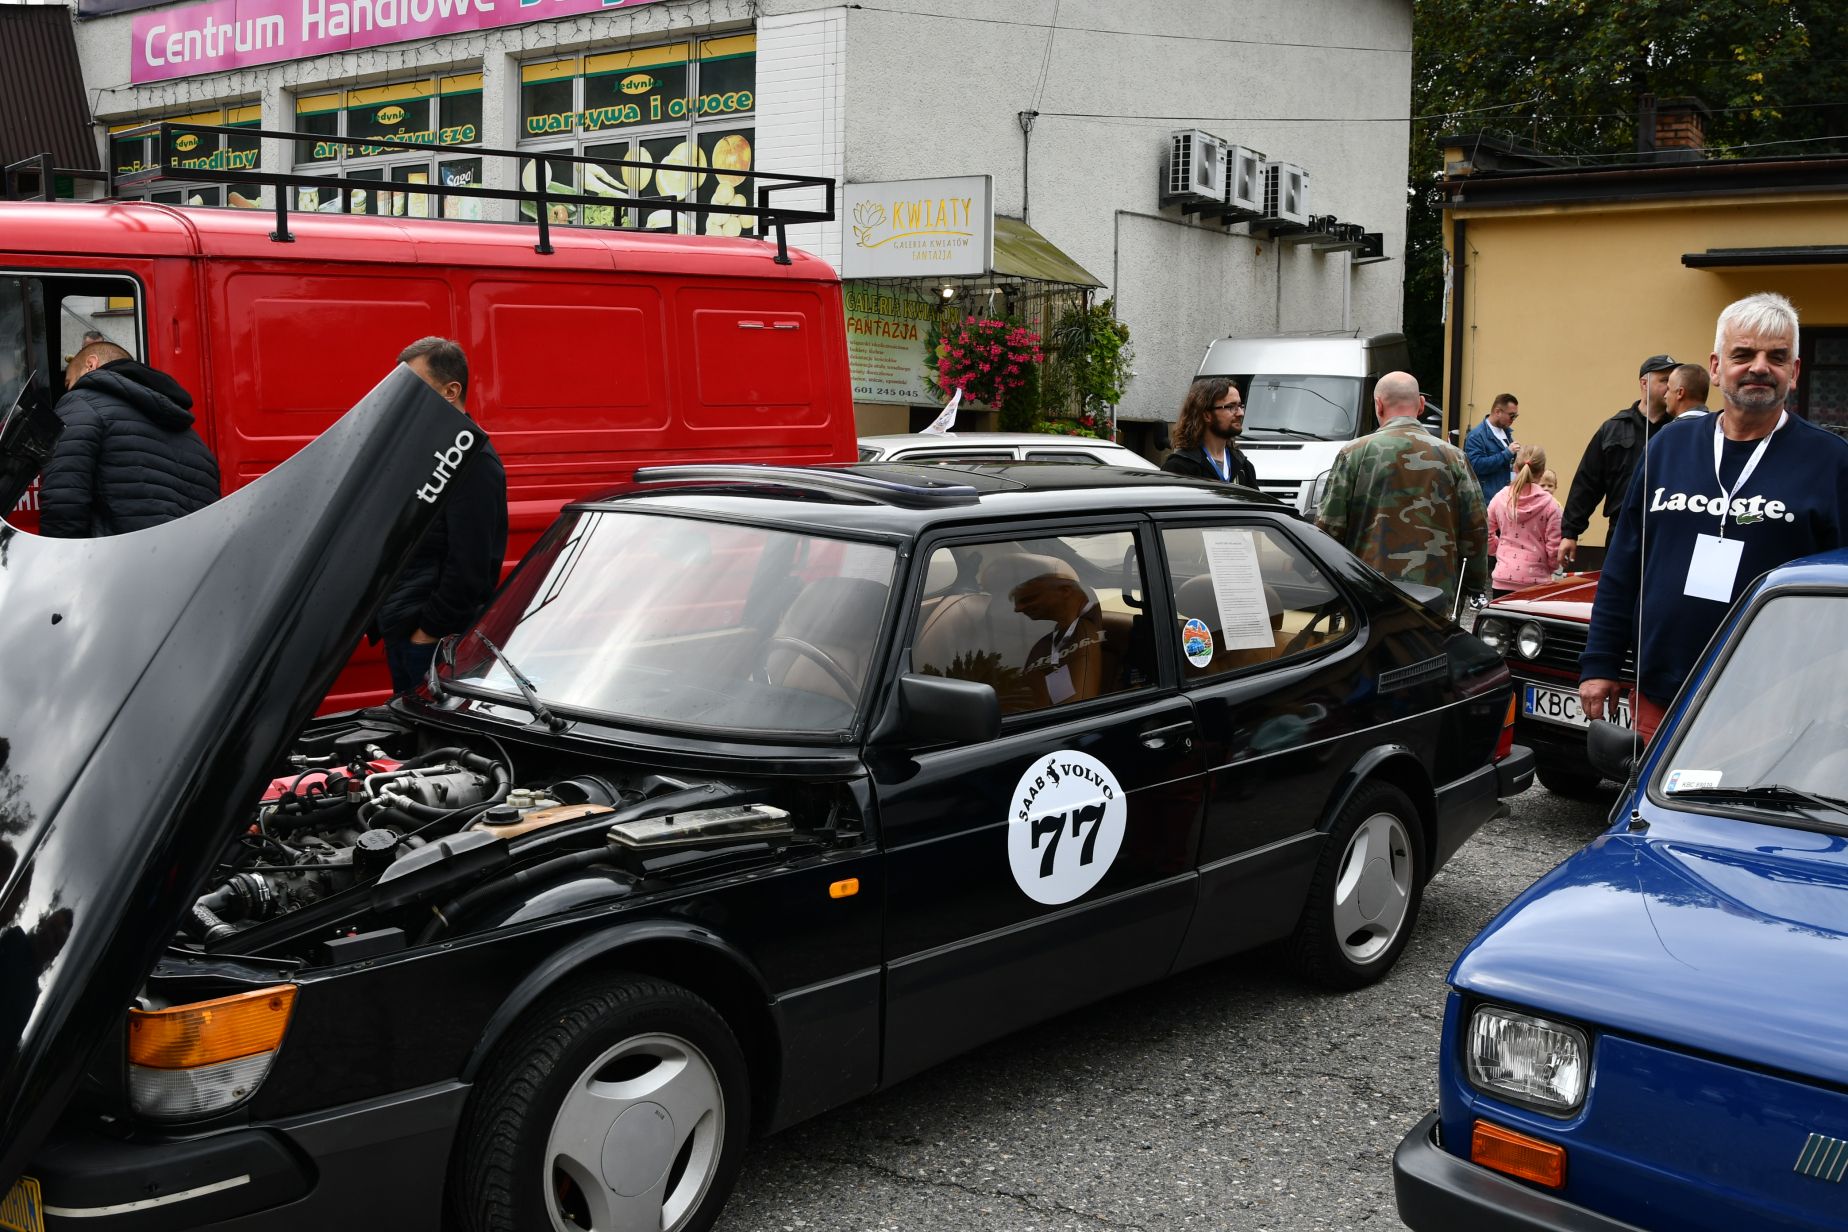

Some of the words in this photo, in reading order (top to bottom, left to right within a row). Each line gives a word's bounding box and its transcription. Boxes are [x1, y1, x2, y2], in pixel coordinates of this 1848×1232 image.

[145, 13, 285, 67] Centrum
[527, 102, 641, 135] warzywa
[649, 95, 662, 120] i
[668, 91, 754, 119] owoce
[892, 197, 972, 231] KWIATY
[893, 239, 928, 250] GALERIA
[930, 237, 970, 249] KWIATÓW
[912, 250, 953, 262] FANTAZJA
[845, 290, 901, 318] GALERIA
[847, 316, 918, 341] FANTAZJA
[854, 386, 873, 395] 601
[876, 387, 897, 396] 245
[898, 389, 919, 398] 045
[416, 430, 475, 503] turbo
[1535, 689, 1577, 720] KBC
[1018, 775, 1046, 822] SAAB
[1059, 763, 1114, 800] VOLVO
[1031, 801, 1107, 879] 77
